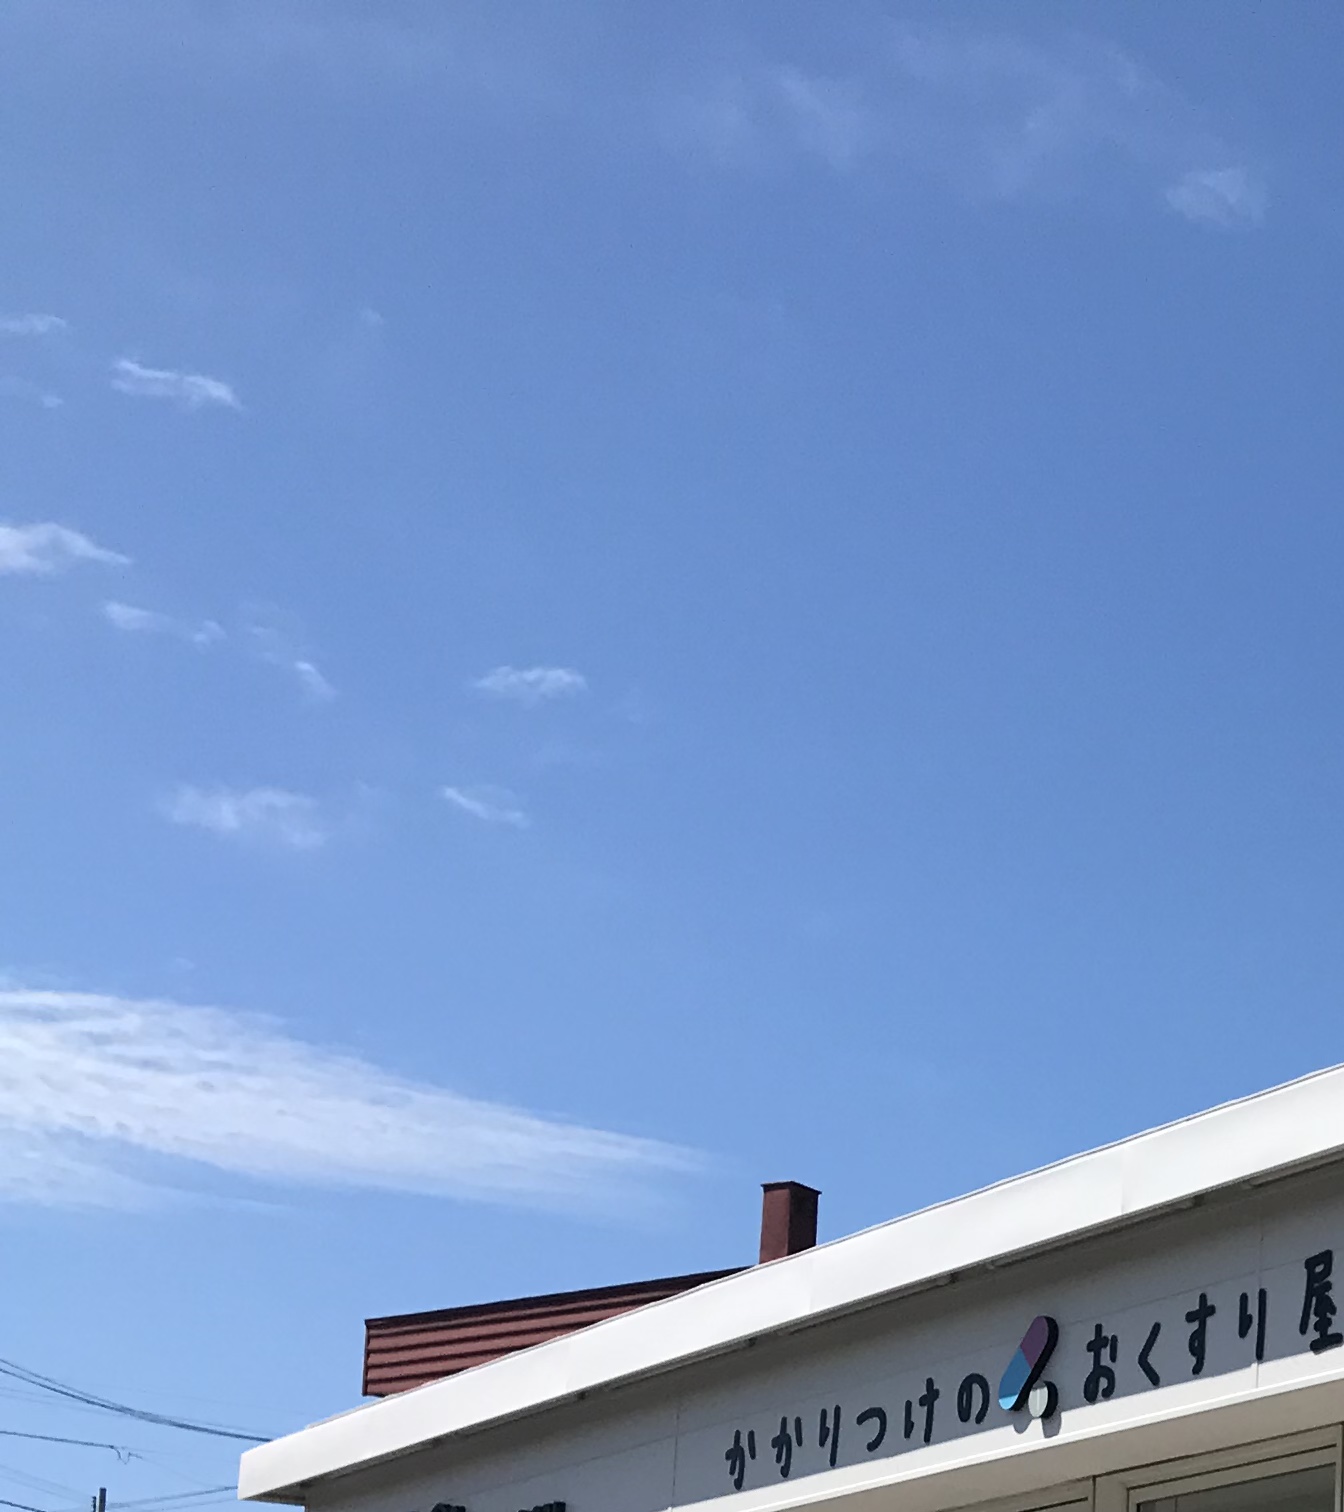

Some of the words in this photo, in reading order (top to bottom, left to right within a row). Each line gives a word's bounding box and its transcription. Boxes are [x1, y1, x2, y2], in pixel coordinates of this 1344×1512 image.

[724, 1372, 991, 1492] かかりつけの
